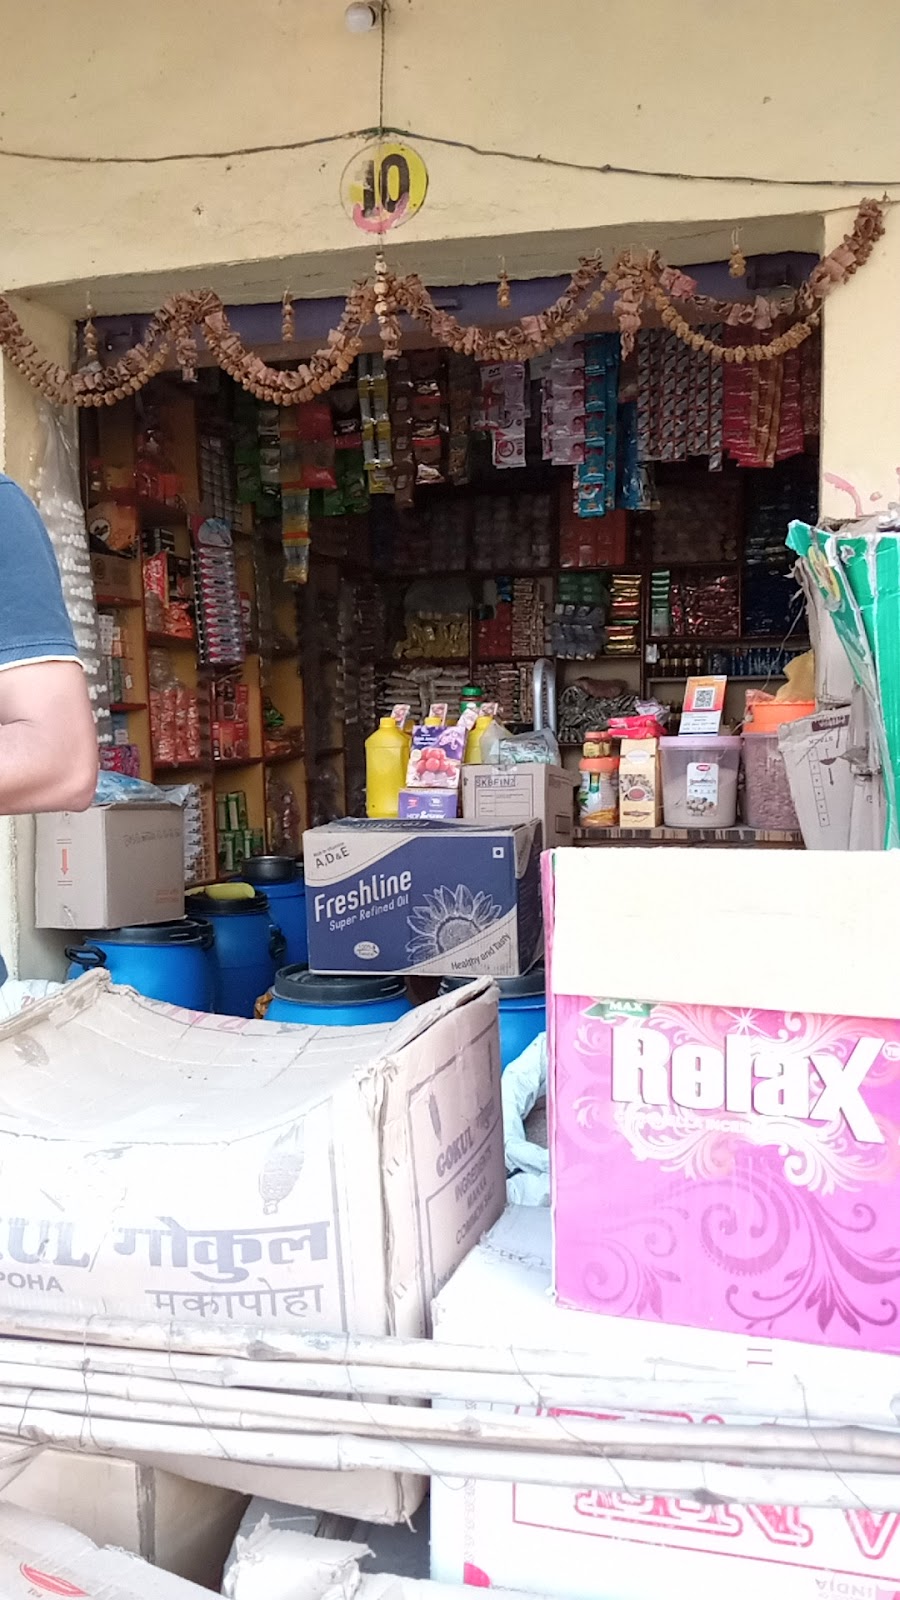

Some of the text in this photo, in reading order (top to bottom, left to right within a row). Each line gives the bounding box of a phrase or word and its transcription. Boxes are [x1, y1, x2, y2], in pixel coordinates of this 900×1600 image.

[357, 153, 410, 218] 10
[314, 870, 412, 922] Freshline
[329, 894, 409, 931] Super Refined Oil
[451, 933, 511, 970] Healthy and Tasty
[609, 1001, 644, 1013] MAX
[435, 1126, 474, 1178] GOKUL
[0, 1215, 90, 1269] UL
[113, 1215, 331, 1284] गोकुल
[145, 1276, 325, 1320] मकापोहा
[814, 1578, 873, 1598] INDIA
